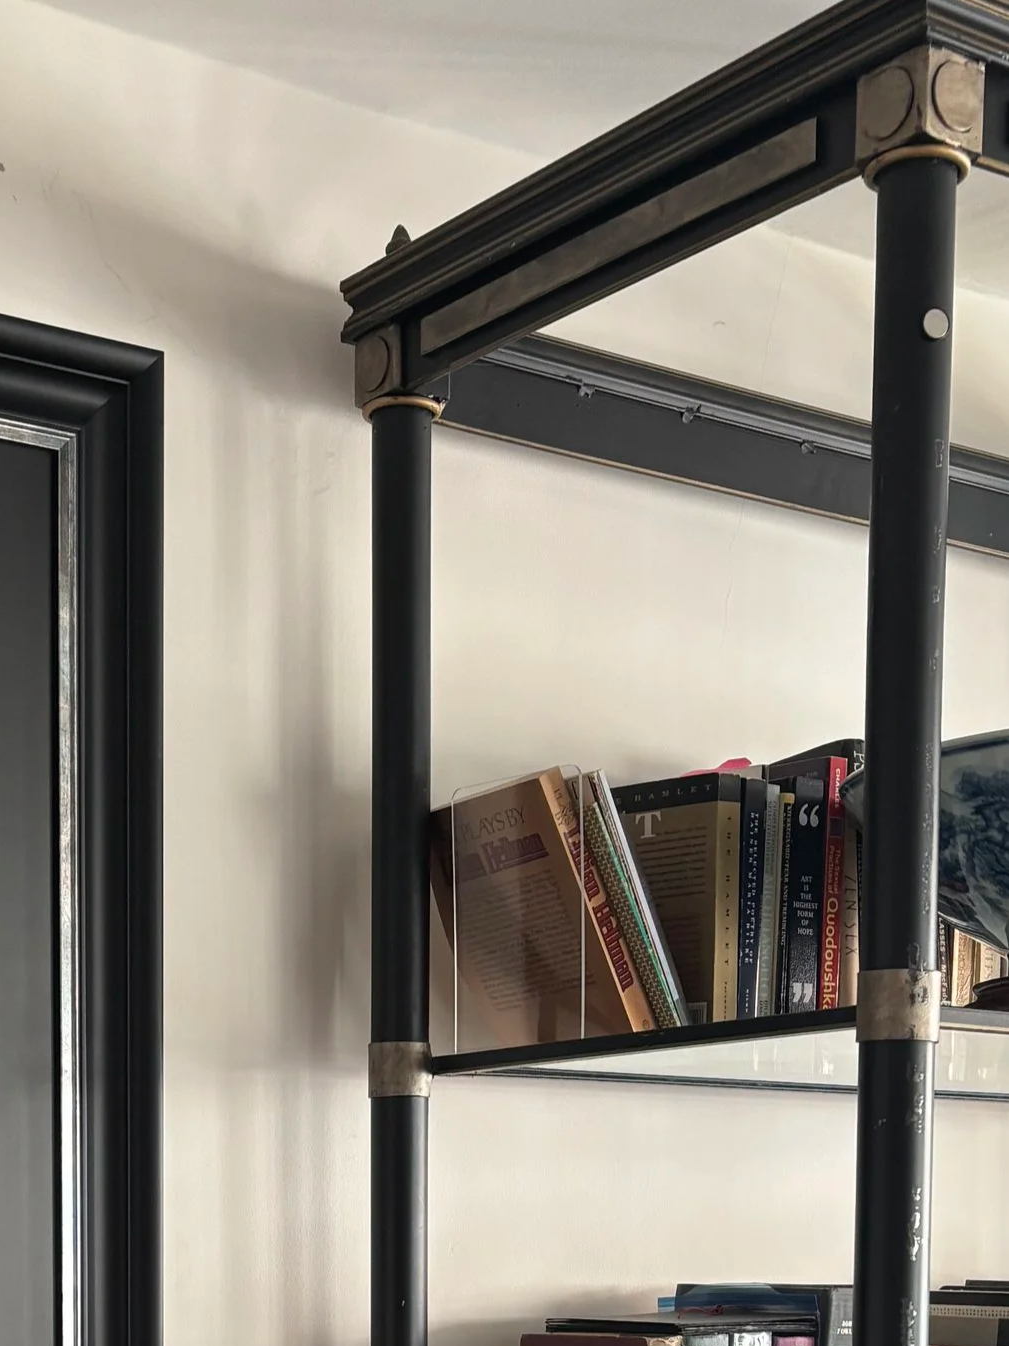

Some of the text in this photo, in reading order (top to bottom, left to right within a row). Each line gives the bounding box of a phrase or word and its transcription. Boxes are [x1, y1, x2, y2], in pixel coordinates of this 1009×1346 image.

[634, 784, 711, 802] HAMLET
[457, 806, 525, 843] PLAYS BY
[750, 839, 759, 897] SELECTED
[826, 846, 835, 894] Practices of
[832, 864, 840, 894] Sexual
[723, 874, 732, 966] HAMLET
[749, 901, 757, 944] POETRY
[780, 902, 788, 946] TREMBLING
[793, 901, 818, 910] HIGHEST
[797, 910, 814, 918] FORM
[844, 875, 858, 956] ZEN SEX
[592, 901, 634, 993] Hellman
[797, 927, 814, 936] HOPE
